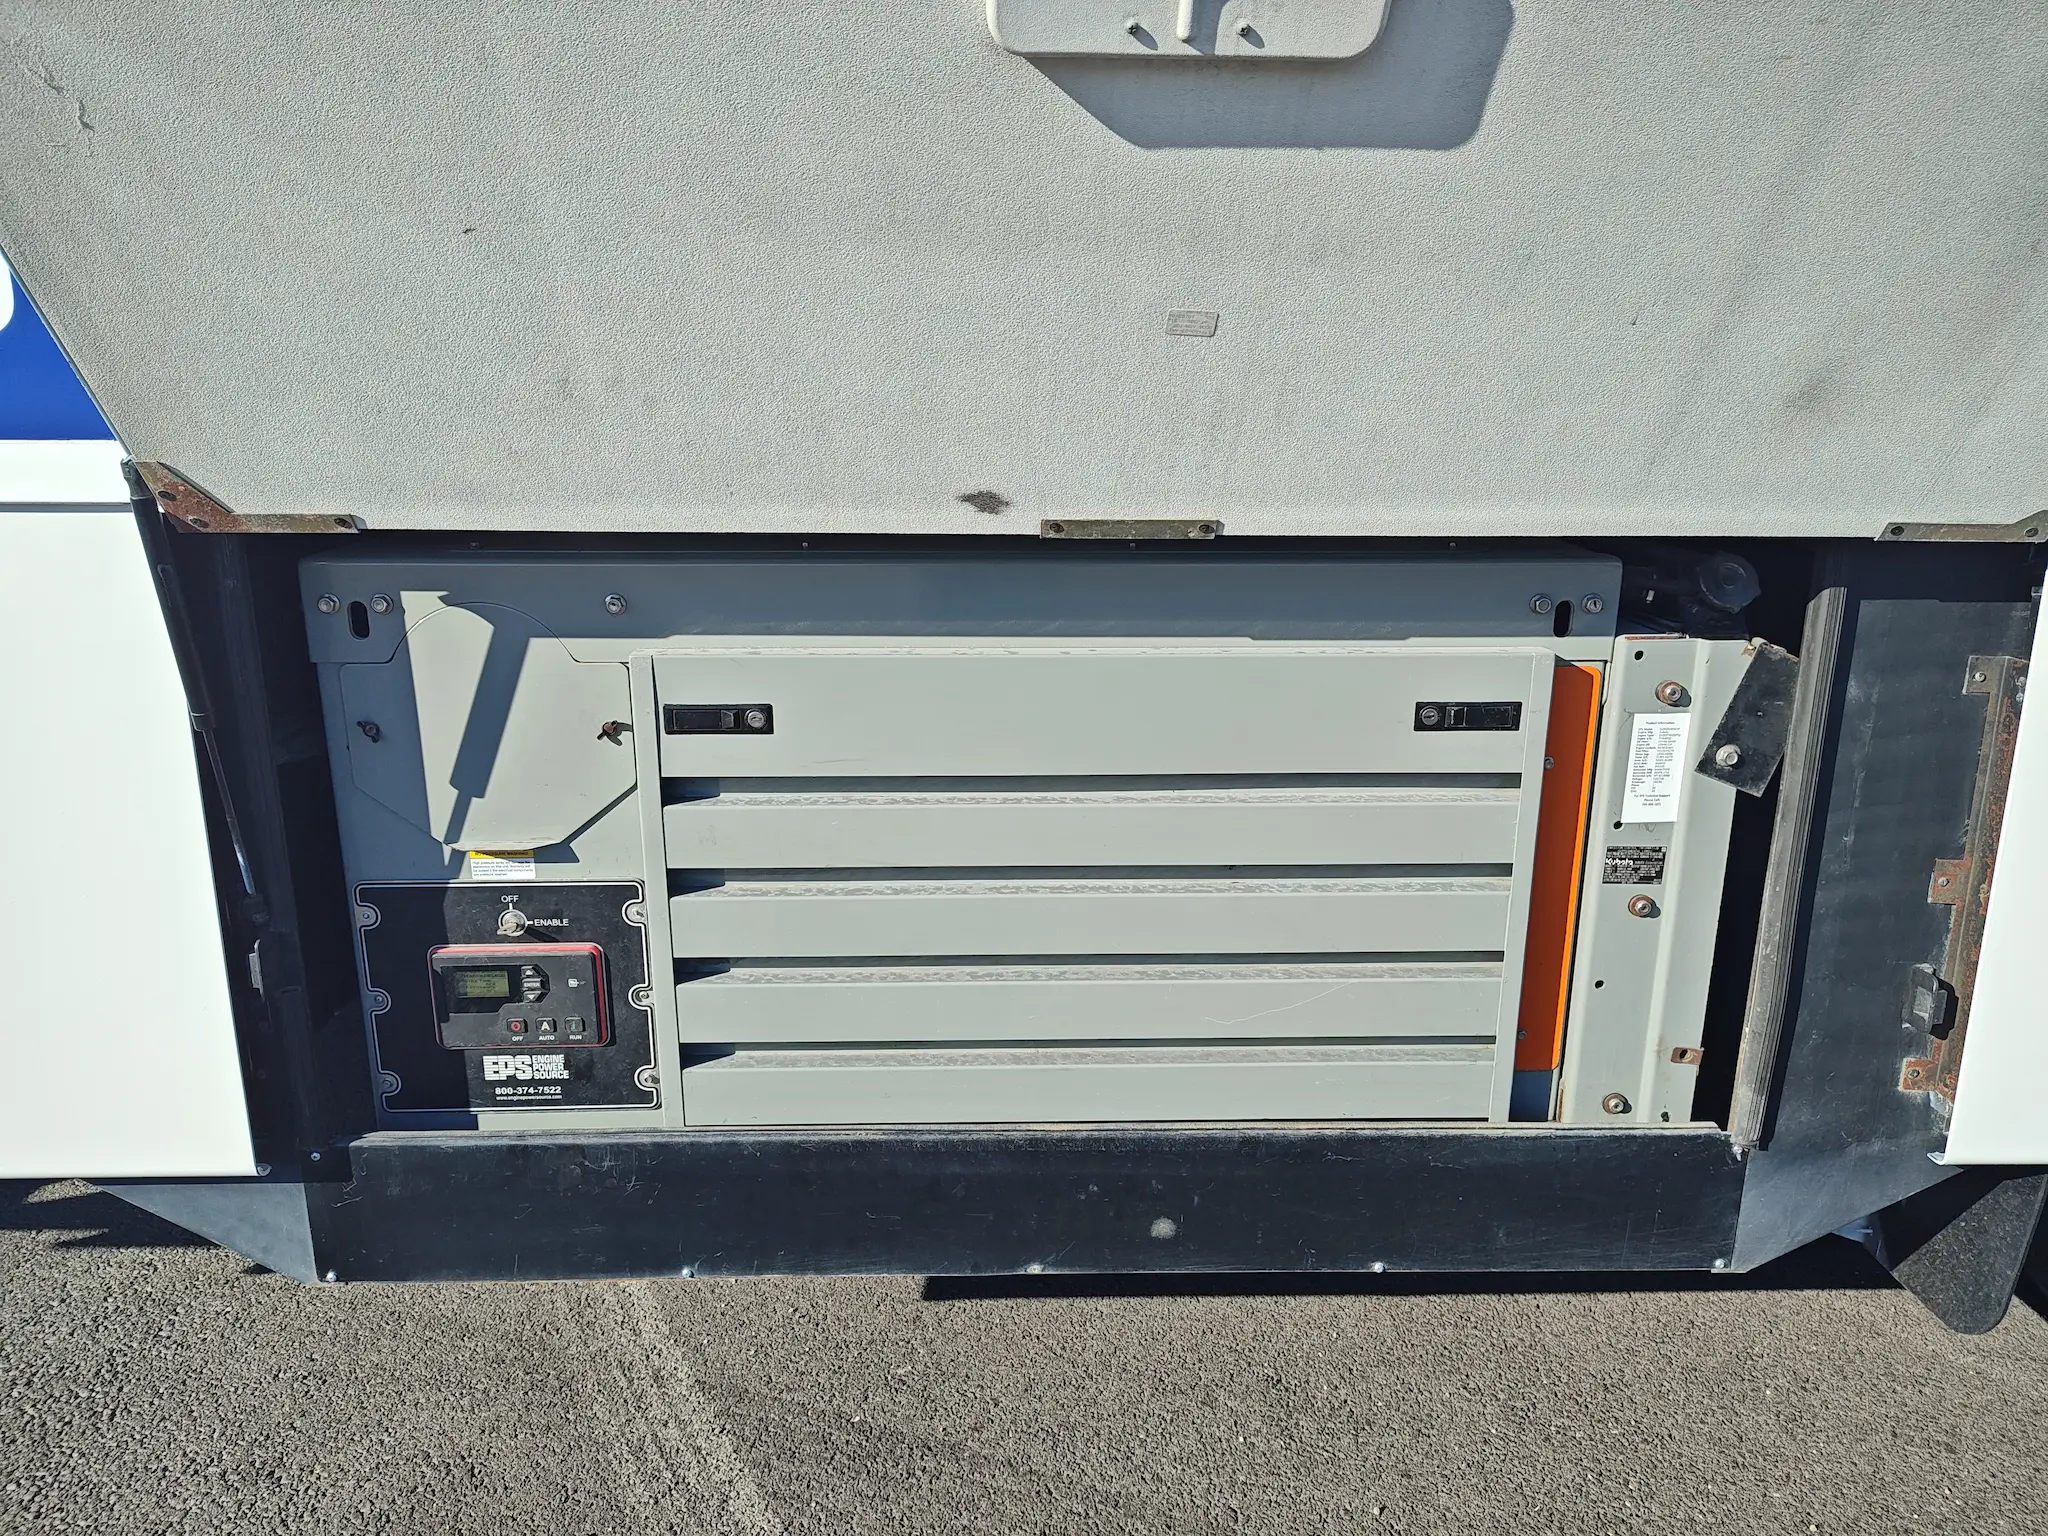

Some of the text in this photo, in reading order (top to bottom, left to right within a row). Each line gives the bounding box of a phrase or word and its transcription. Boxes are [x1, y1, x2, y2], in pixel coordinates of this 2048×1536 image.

[1605, 857, 1634, 866] Kubota
[501, 895, 519, 903] OFF
[534, 918, 569, 927] ENABLE
[531, 1054, 565, 1063] ENGINE
[482, 1054, 533, 1081] EPS
[533, 1063, 564, 1071] POWER
[533, 1070, 570, 1080] SOURCE
[495, 1086, 562, 1095] 800-374-7522
